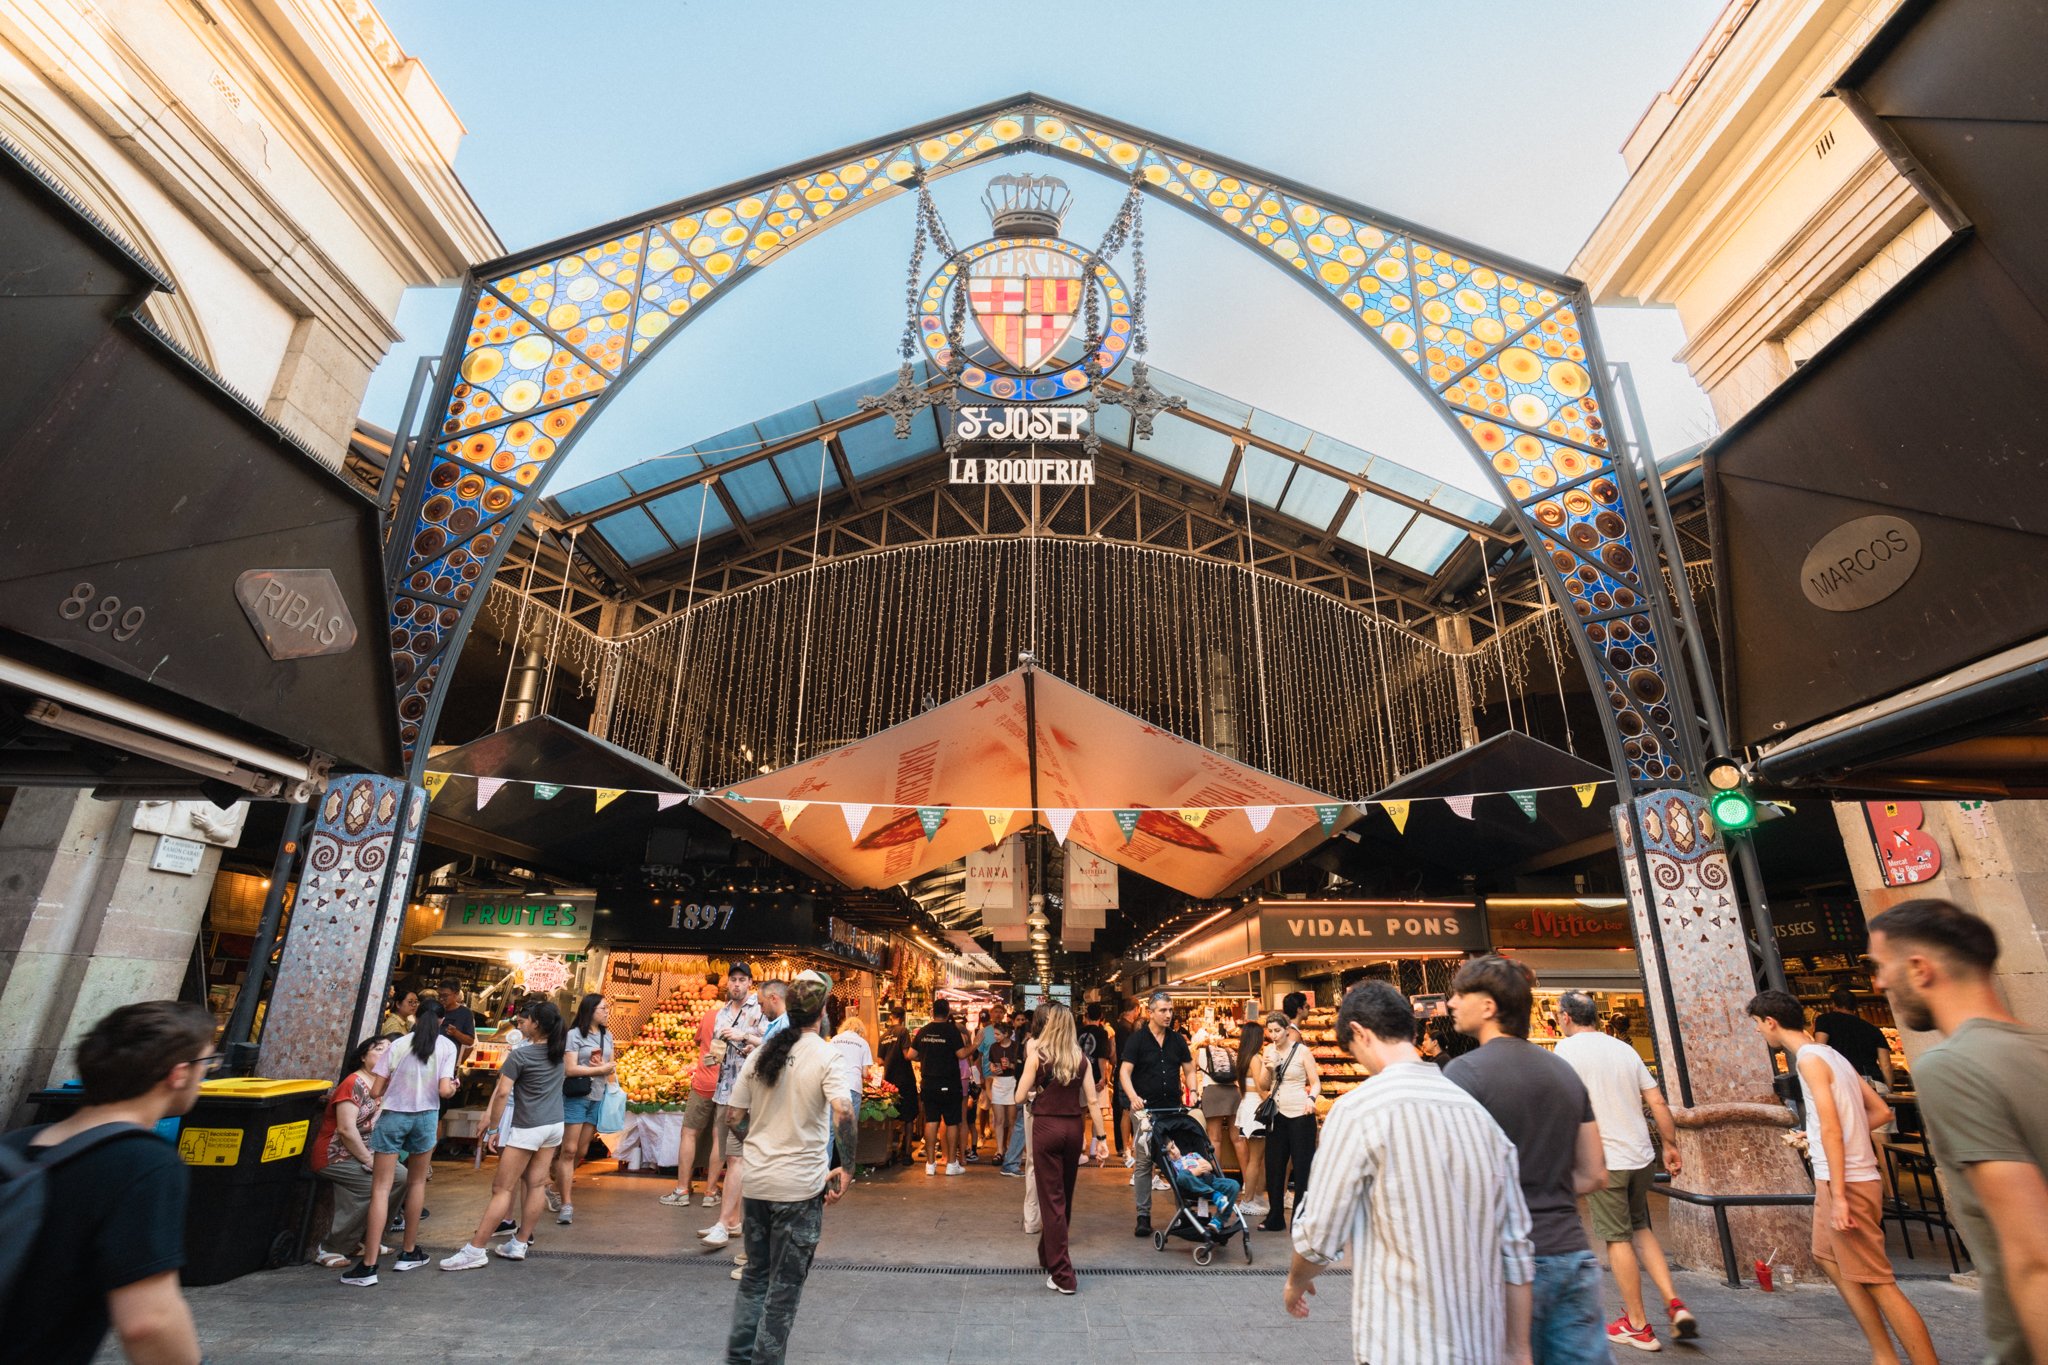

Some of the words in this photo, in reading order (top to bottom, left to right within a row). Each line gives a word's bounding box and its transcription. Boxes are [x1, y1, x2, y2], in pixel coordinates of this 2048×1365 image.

[975, 251, 1079, 277] MERCAT
[988, 407, 1089, 440] JOSEP
[950, 459, 979, 484] LA
[985, 459, 1094, 484] BOQUERIA
[1810, 528, 1909, 599] MARCOS
[59, 582, 146, 642] 889
[253, 577, 345, 647] RIBAS
[970, 867, 1009, 878] CANYA
[1888, 858, 1908, 867] Mercat
[1905, 861, 1932, 872] Boqueria
[462, 904, 577, 927] FRUITES
[668, 903, 734, 930] 1897
[1287, 919, 1373, 937] VIDAL
[1386, 918, 1460, 936] PONS
[1788, 921, 1816, 937] SECS
